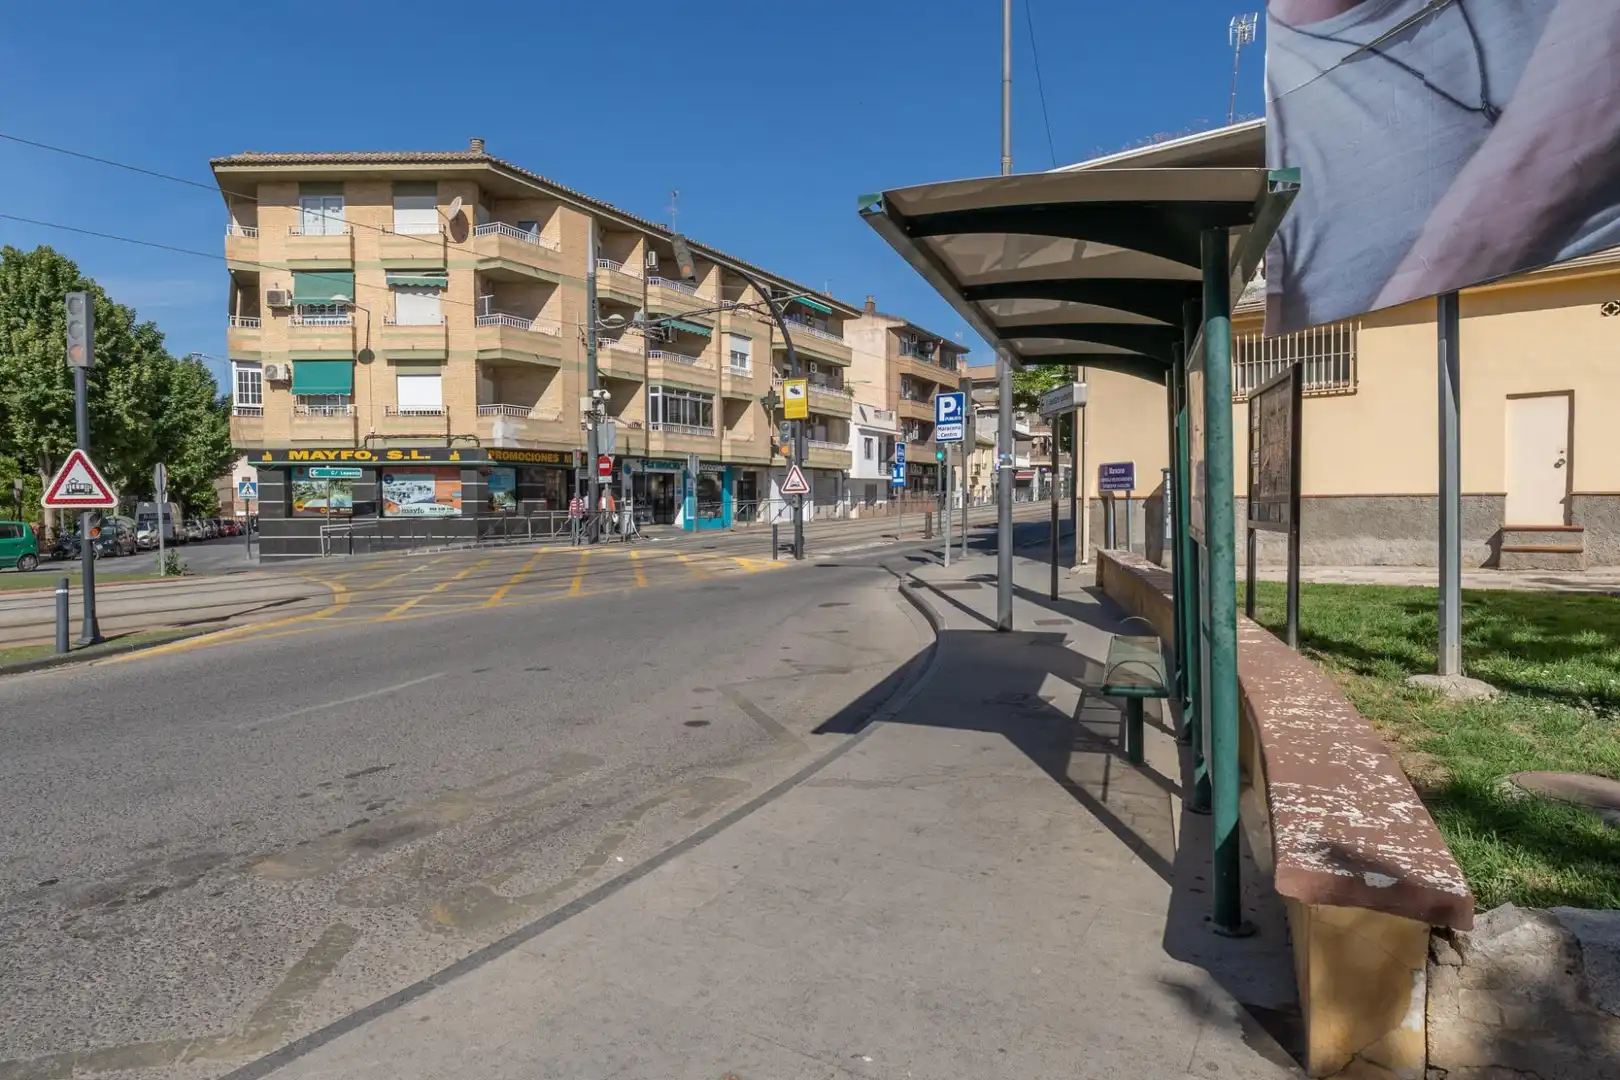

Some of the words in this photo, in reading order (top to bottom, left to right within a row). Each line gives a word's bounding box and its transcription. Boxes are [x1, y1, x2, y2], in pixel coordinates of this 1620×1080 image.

[937, 424, 962, 432] Maracena
[288, 450, 378, 462] MAYFO,
[386, 449, 432, 460] S.L.
[487, 449, 560, 463] PROMOCIONES
